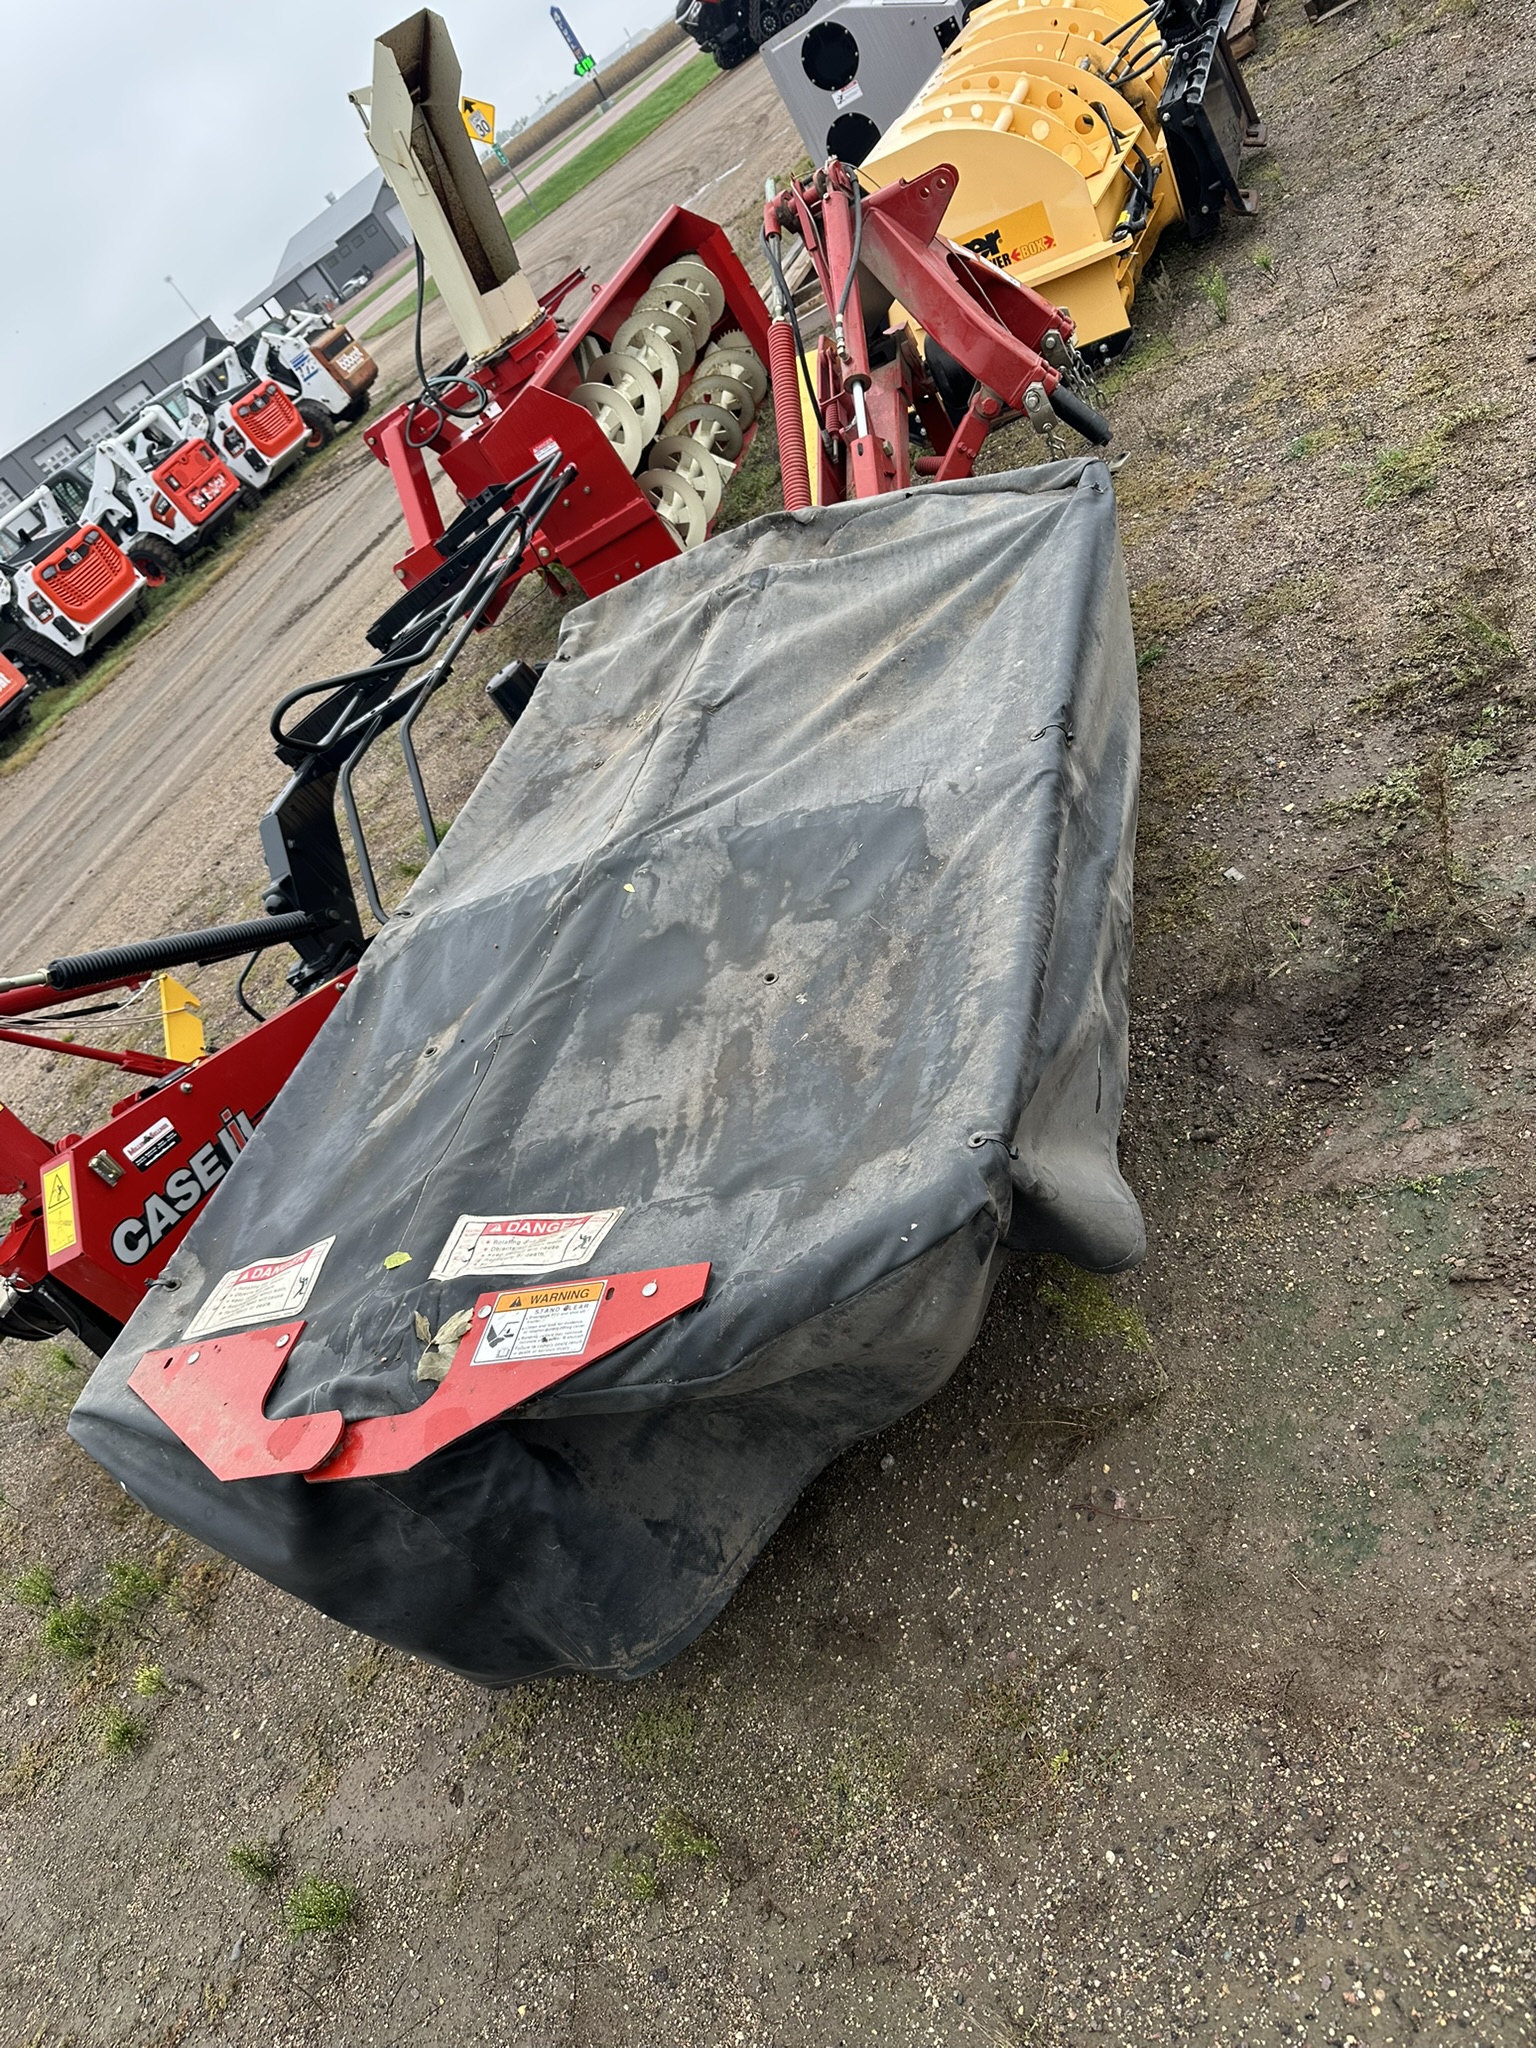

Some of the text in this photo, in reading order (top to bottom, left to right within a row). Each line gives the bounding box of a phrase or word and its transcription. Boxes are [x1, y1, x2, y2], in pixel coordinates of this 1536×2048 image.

[476, 119, 491, 137] 30
[1019, 238, 1045, 260] BOX
[111, 1140, 228, 1265] CASE
[530, 1288, 590, 1305] WARNING
[534, 1307, 561, 1315] STAND
